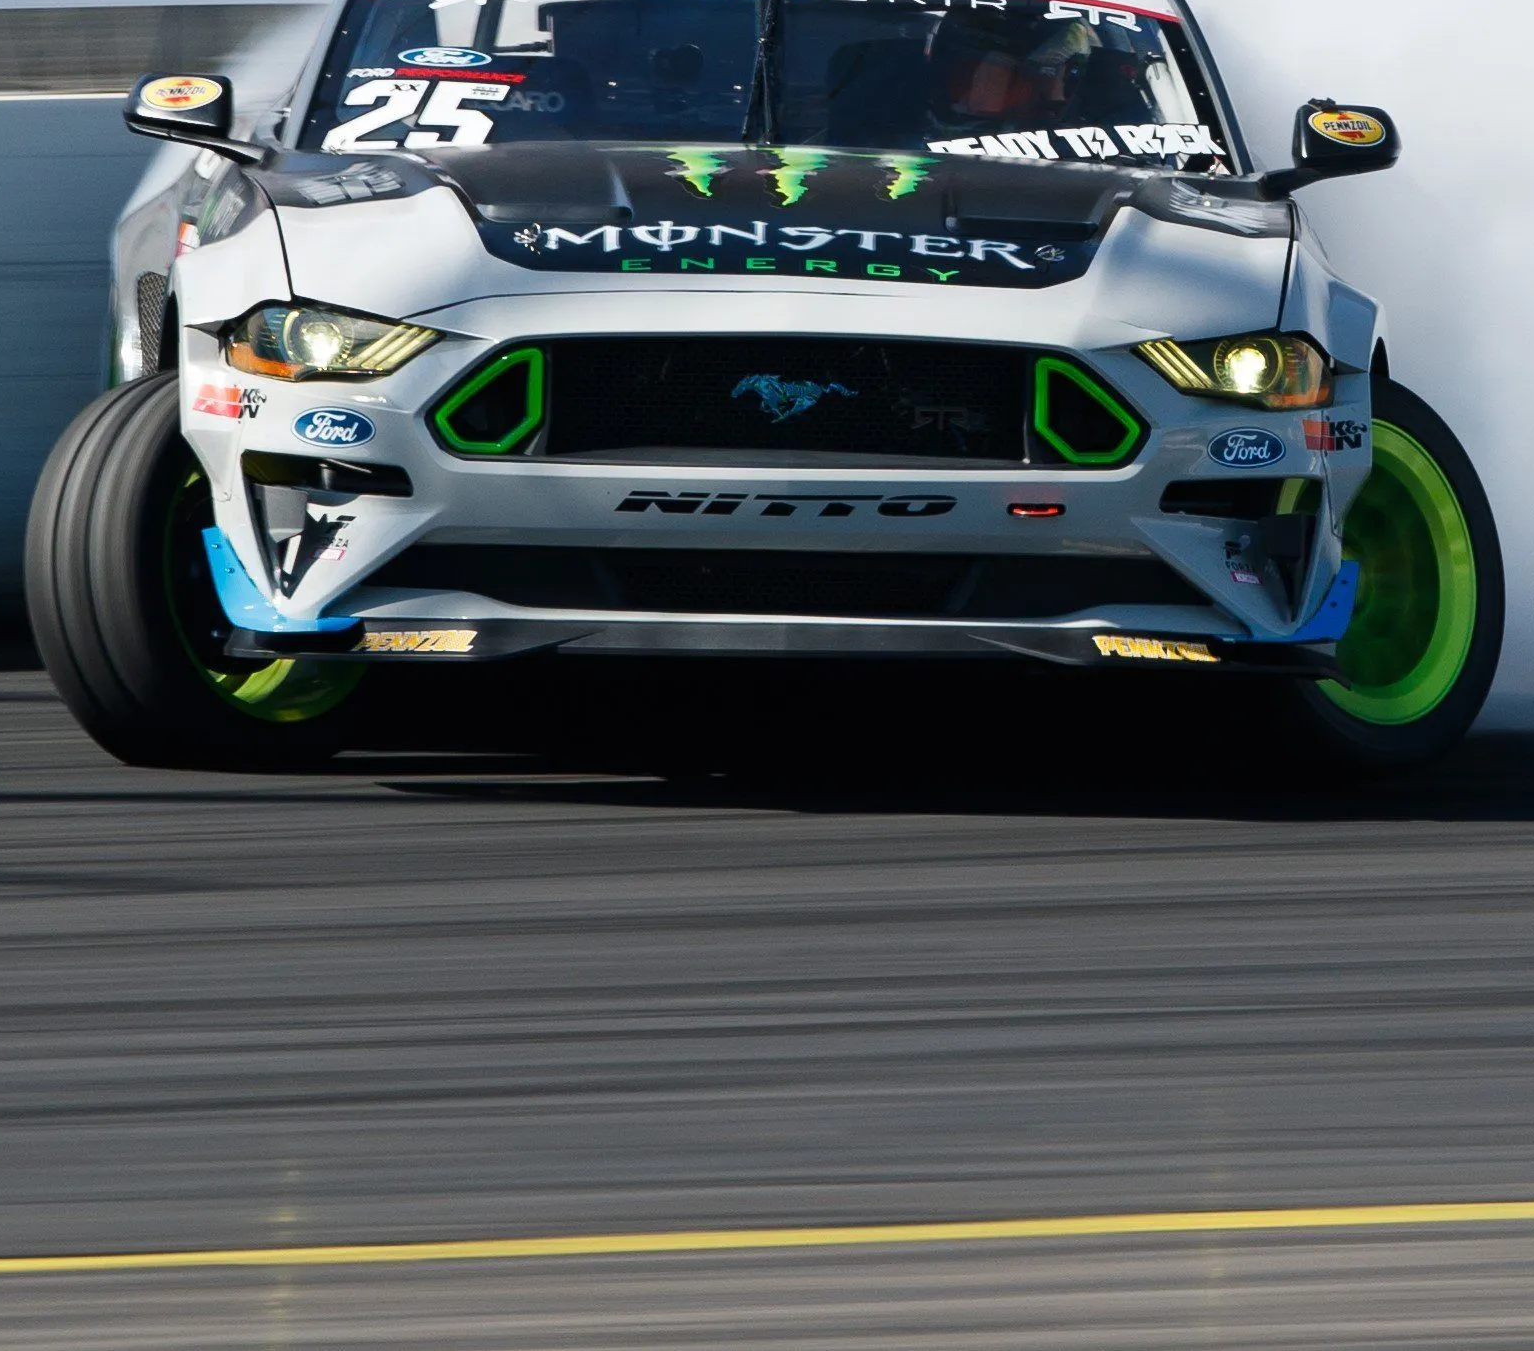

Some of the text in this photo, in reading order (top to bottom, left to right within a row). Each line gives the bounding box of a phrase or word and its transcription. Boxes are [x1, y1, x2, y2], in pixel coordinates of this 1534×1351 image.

[321, 79, 511, 152] 25
[1323, 120, 1372, 131] PENNZOIL
[1056, 127, 1119, 161] TO
[540, 220, 1036, 270] MONSTER
[622, 257, 960, 282] ENERGY
[305, 411, 359, 442] Ford
[1223, 434, 1271, 461] Ford
[614, 490, 959, 518] NITTO
